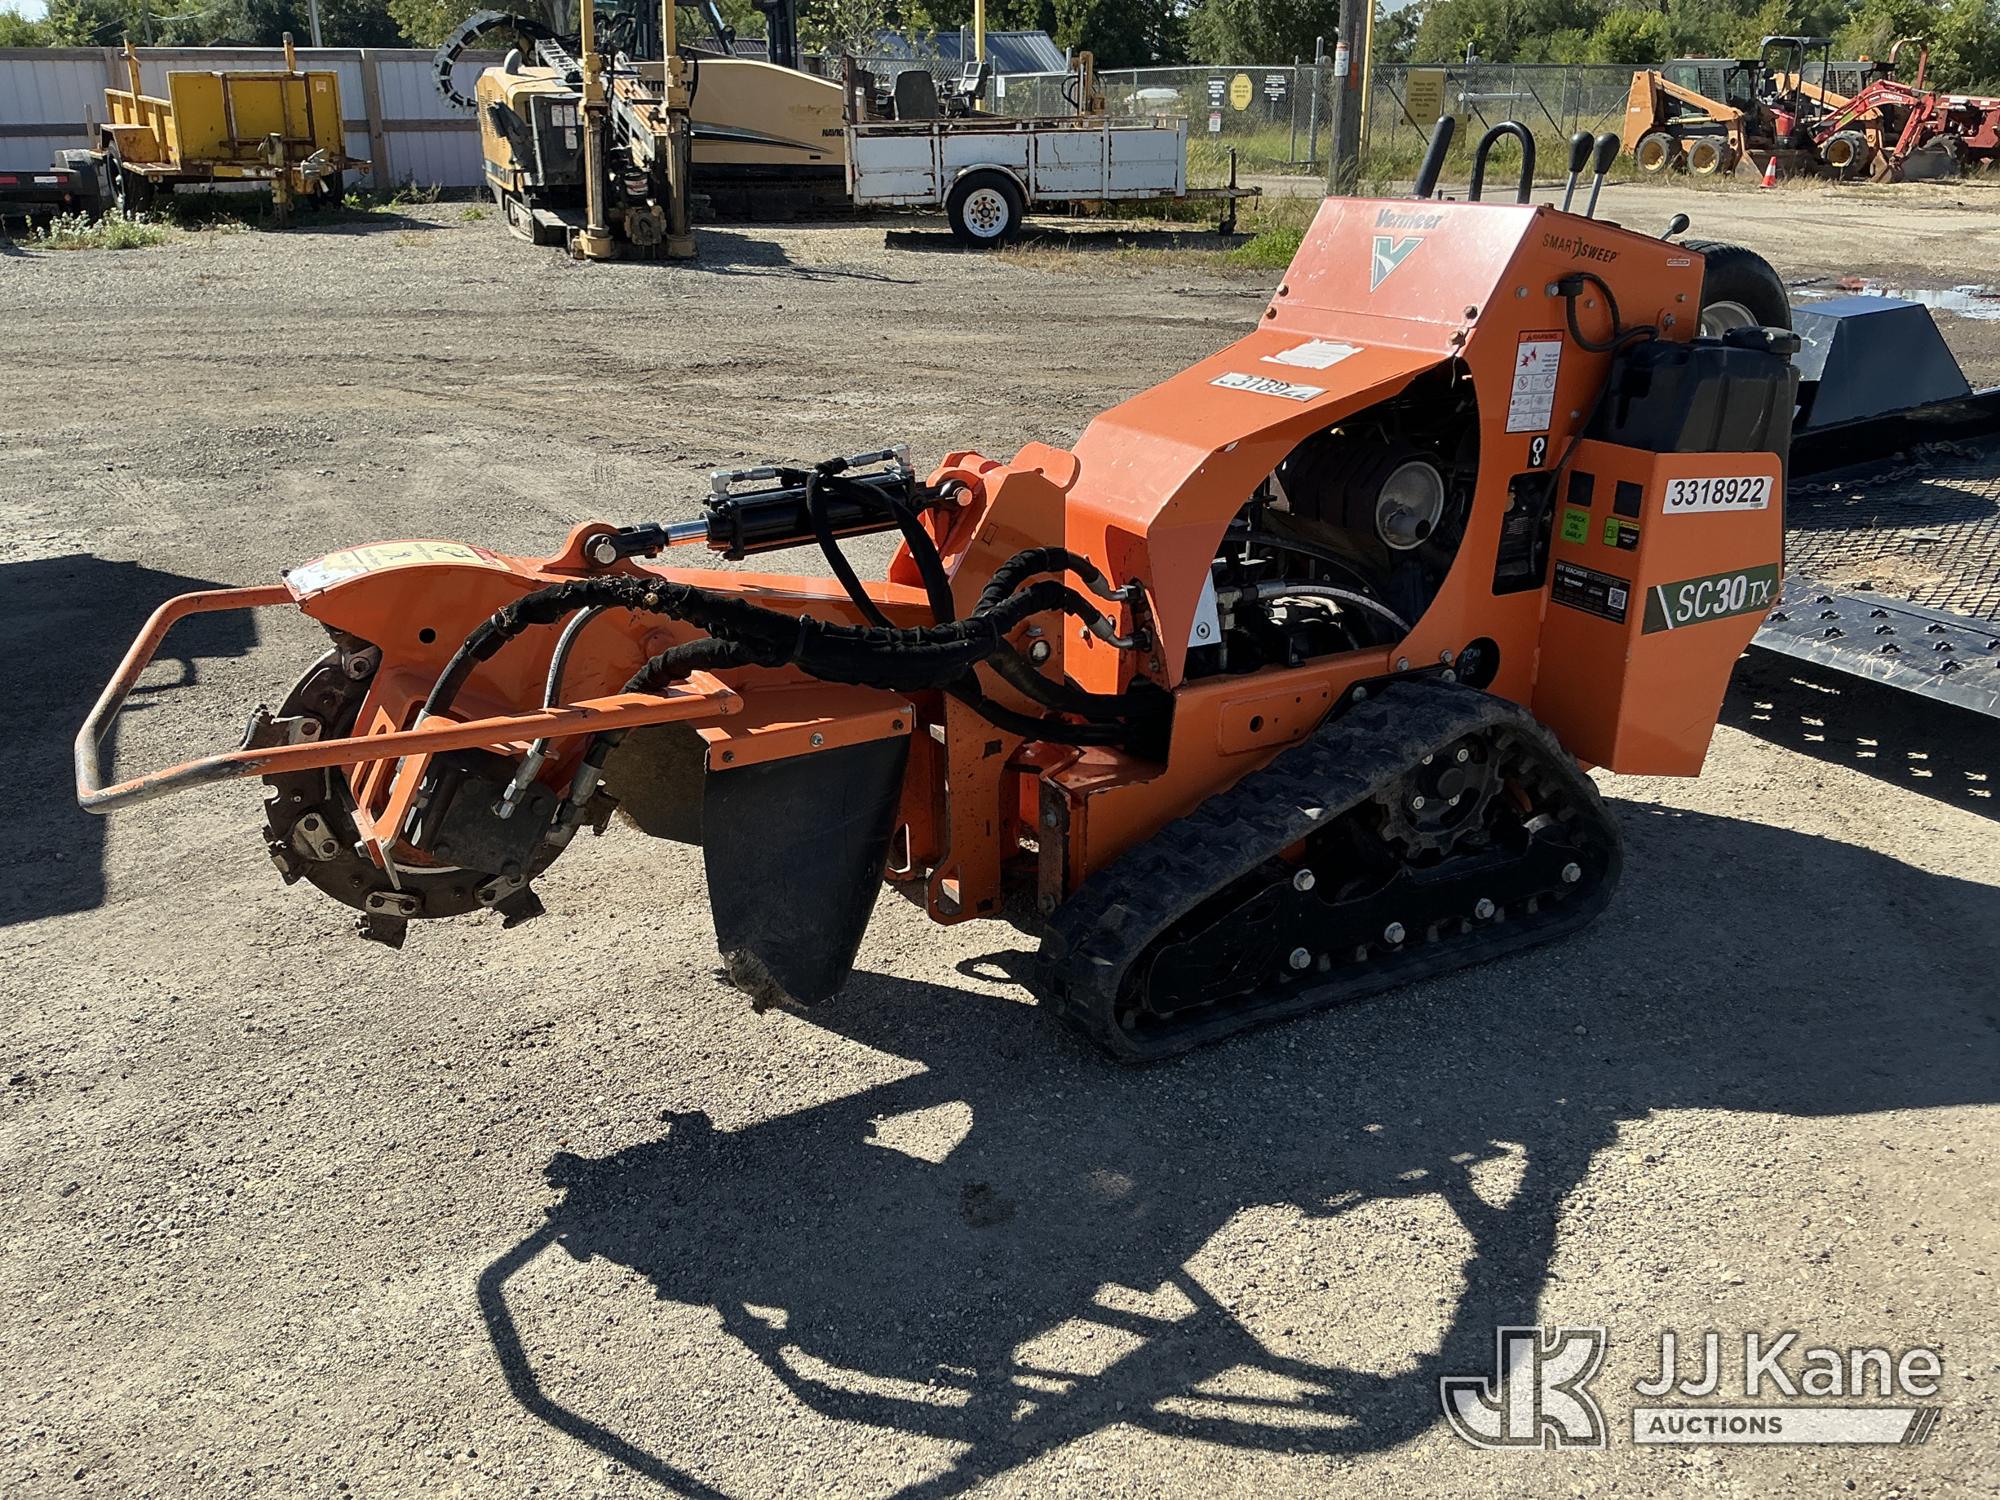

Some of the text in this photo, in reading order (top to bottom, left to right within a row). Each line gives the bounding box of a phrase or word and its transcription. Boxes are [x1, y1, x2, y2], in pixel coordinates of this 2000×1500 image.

[822, 128, 845, 137] NAVIG
[1375, 208, 1443, 229] Vermeer
[1671, 477, 1765, 506] 3318922
